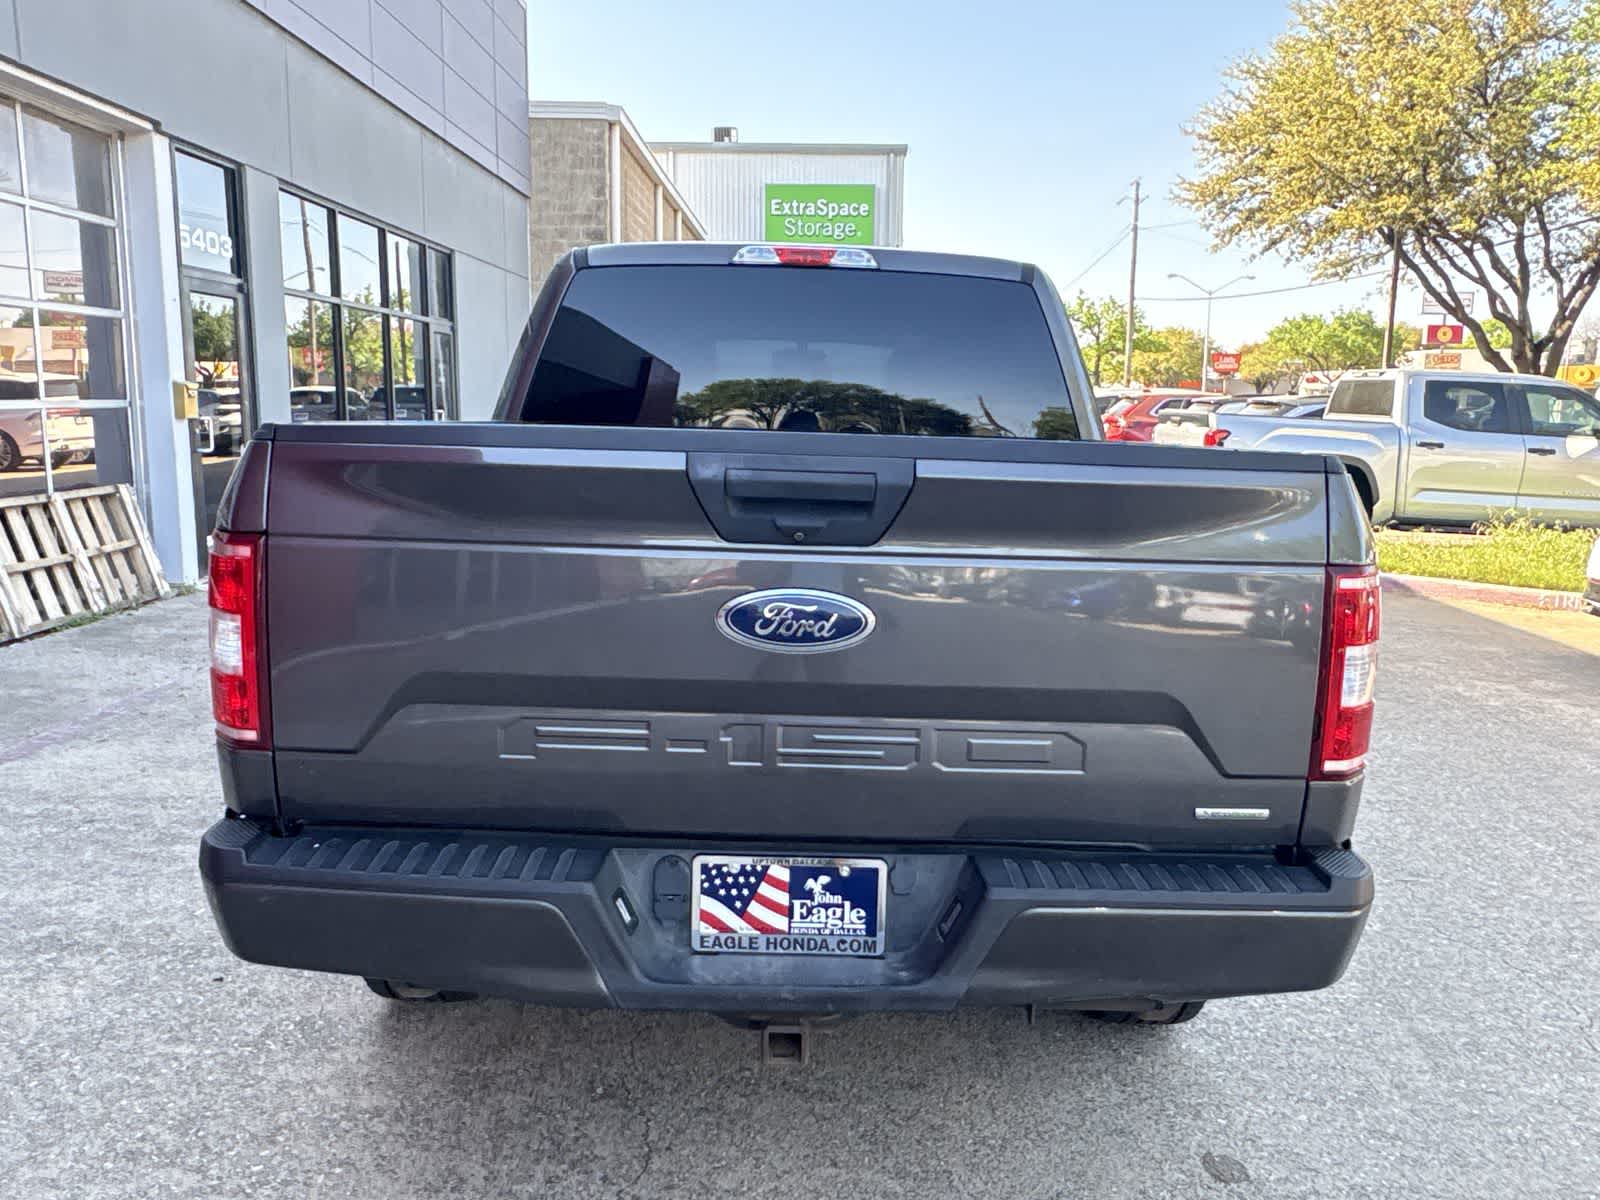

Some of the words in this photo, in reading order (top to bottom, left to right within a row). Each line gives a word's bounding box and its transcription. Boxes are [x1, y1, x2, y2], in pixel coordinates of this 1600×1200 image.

[770, 198, 869, 219] ExtraSpace
[754, 602, 838, 638] Ford
[498, 717, 1087, 775] F-150
[813, 893, 843, 908] John
[791, 899, 868, 929] Eagle
[833, 928, 867, 937] DALLAS
[699, 935, 760, 951] EAGLE
[765, 938, 878, 954] HONDA.COM
